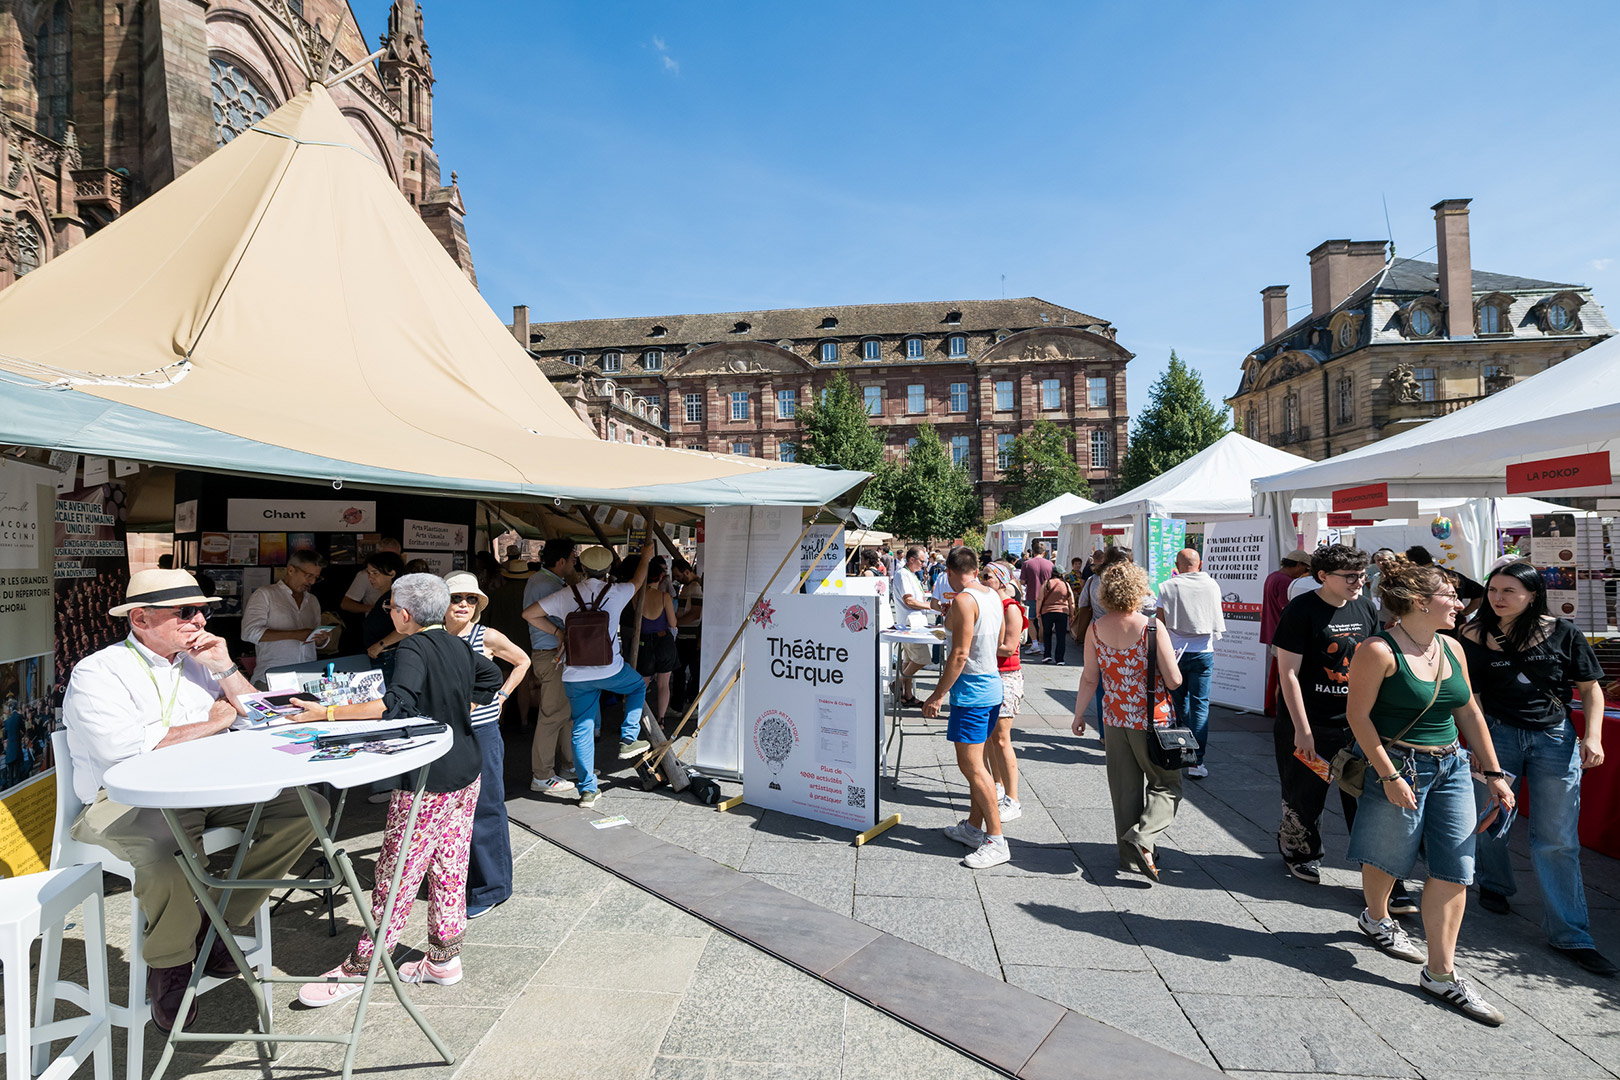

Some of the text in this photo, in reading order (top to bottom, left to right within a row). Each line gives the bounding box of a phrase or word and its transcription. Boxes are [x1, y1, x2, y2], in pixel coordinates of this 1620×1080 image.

[1527, 468, 1580, 481] LA POKOP
[68, 502, 102, 514] AVENTURE
[76, 513, 84, 522] ET
[84, 514, 114, 525] HUMAINE
[263, 510, 306, 518] Chant
[0, 520, 36, 530] ACOMO
[66, 524, 92, 534] UNIQUE
[4, 532, 34, 540] CCINI
[8, 576, 20, 586] LES
[20, 576, 48, 584] GRANDES
[3, 591, 14, 599] DU
[0, 603, 26, 613] CHORAL
[766, 637, 848, 662] Théâtre
[771, 658, 844, 686] Cirque
[1315, 684, 1349, 694] HALLO
[820, 765, 834, 773] Plus
[816, 775, 842, 784] activités
[809, 784, 842, 794] artistiques
[814, 794, 842, 804] pratiquer
